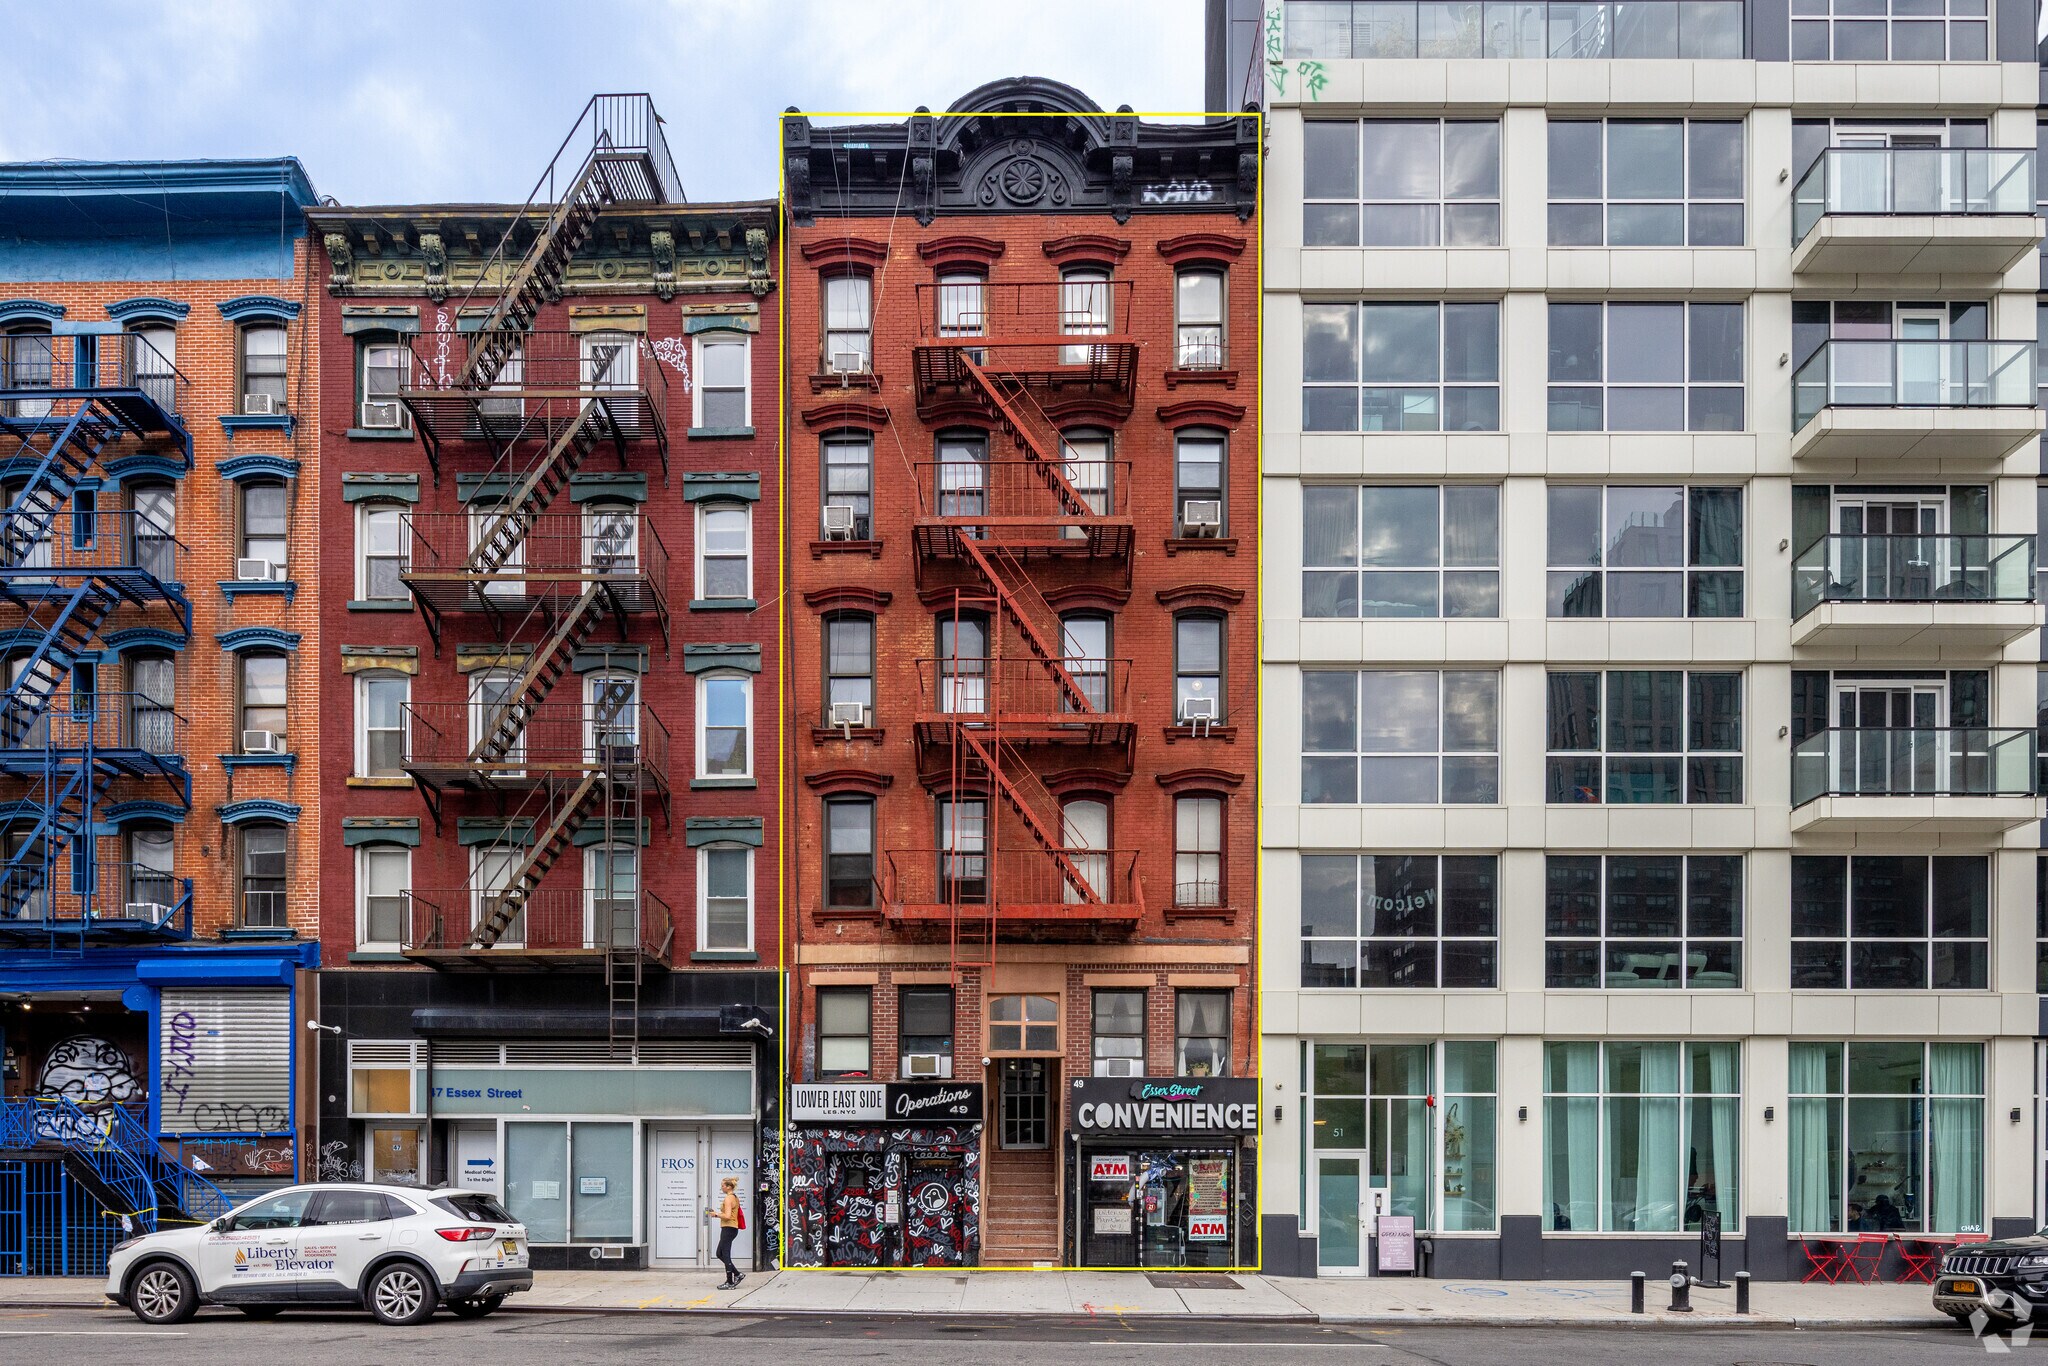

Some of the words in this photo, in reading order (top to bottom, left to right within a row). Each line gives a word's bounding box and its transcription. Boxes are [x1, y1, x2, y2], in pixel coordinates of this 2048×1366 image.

[1073, 1079, 1084, 1088] 49
[446, 1087, 481, 1098] Essex
[487, 1088, 523, 1098] Street
[1141, 1083, 1168, 1100] Essex
[1169, 1084, 1201, 1097] Street
[796, 1090, 829, 1108] LOWER
[833, 1090, 857, 1108] EAST
[859, 1090, 882, 1108] SIDE
[895, 1087, 972, 1117] Operations
[949, 1105, 969, 1114] 49
[1078, 1102, 1257, 1129] CONVENIENCE
[1333, 1128, 1344, 1137] 51
[661, 1158, 695, 1170] FROS
[716, 1158, 749, 1170] FROS
[1093, 1163, 1128, 1175] ATM
[1190, 1223, 1225, 1235] ATM
[247, 1247, 297, 1260] Liberty
[275, 1259, 334, 1270] Elevator
